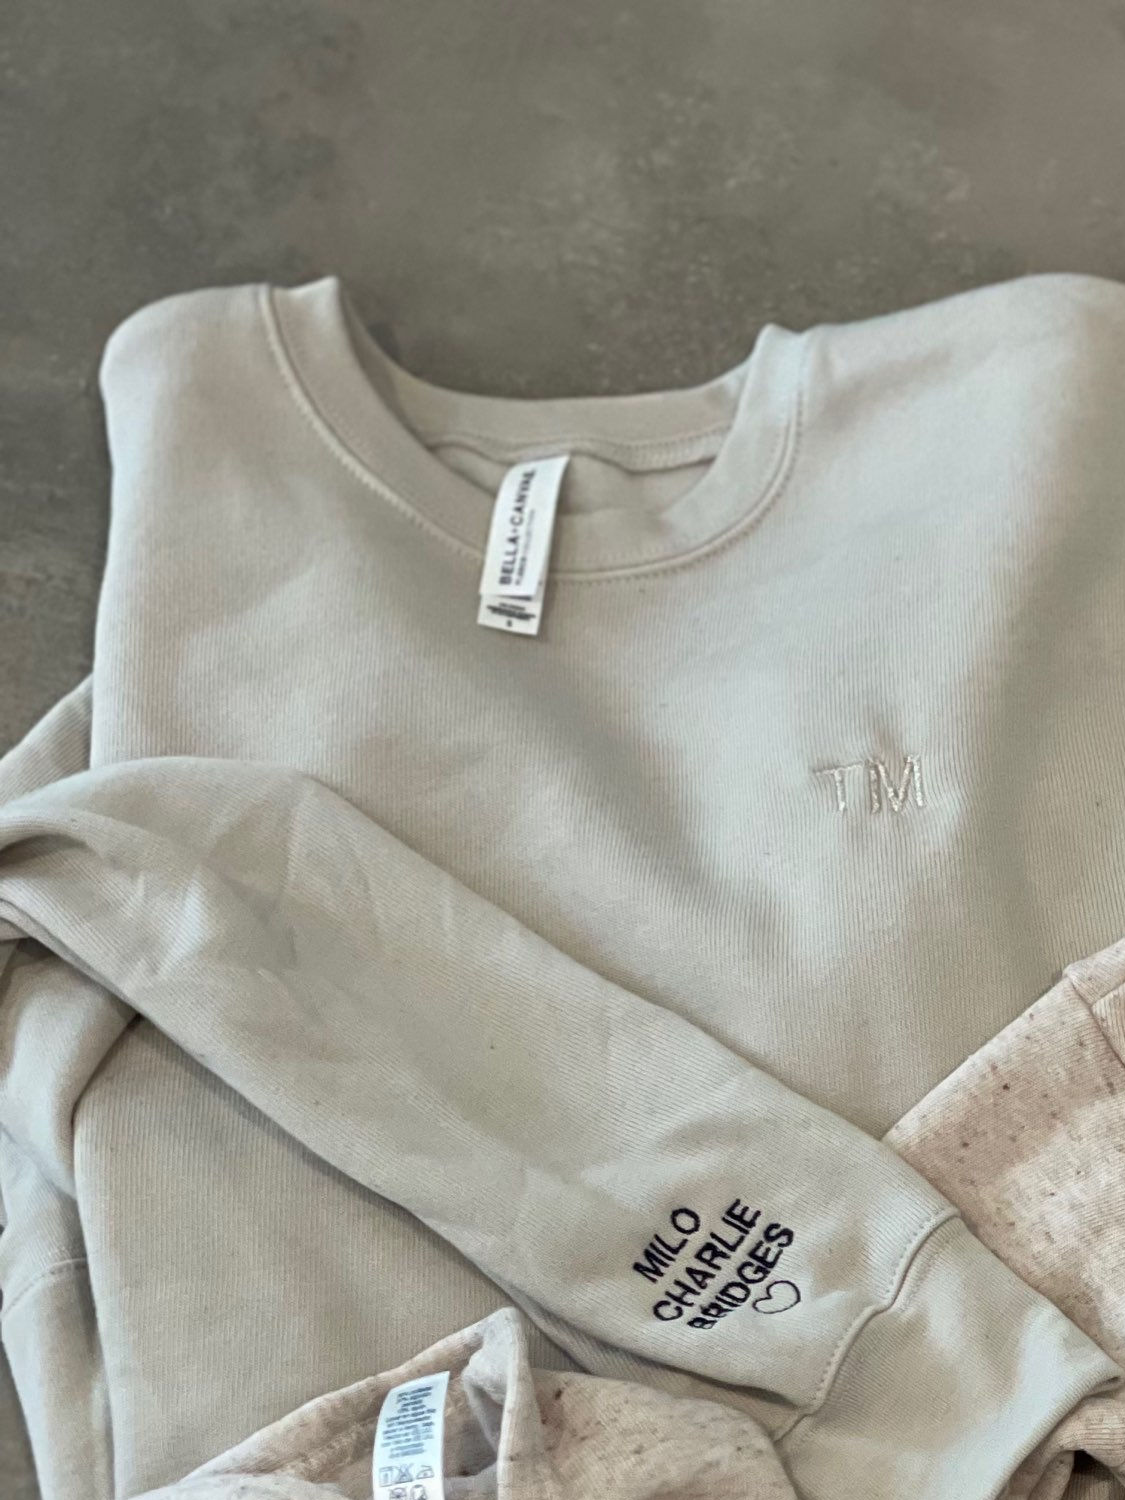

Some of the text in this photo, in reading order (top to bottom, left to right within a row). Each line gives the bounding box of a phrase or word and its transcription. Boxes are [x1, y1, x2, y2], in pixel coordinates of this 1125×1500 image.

[812, 756, 925, 813] TM
[632, 1207, 701, 1284] MILO
[653, 1198, 761, 1322] CHARLIE
[687, 1223, 794, 1330] BRIDGES
